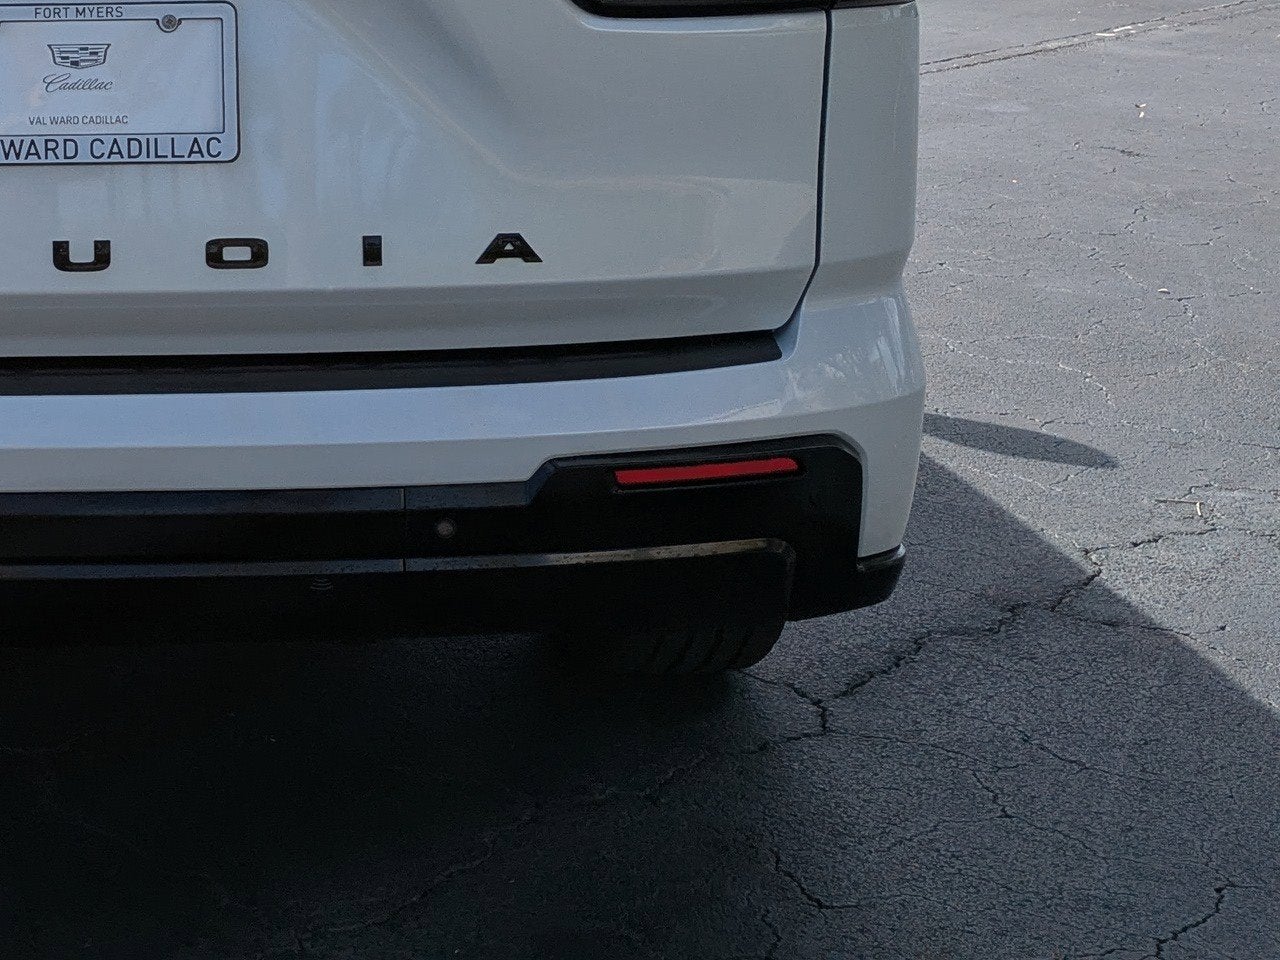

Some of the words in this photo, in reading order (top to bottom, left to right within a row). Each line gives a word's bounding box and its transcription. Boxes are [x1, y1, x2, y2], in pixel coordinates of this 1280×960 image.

[33, 6, 71, 20] FORT
[74, 5, 125, 19] MYERS
[42, 72, 115, 93] Cadillac
[28, 116, 48, 126] VAL
[49, 115, 80, 126] WARD
[81, 114, 129, 125] CADILLAC
[0, 138, 80, 161] WARD
[88, 136, 222, 161] CADILLAC
